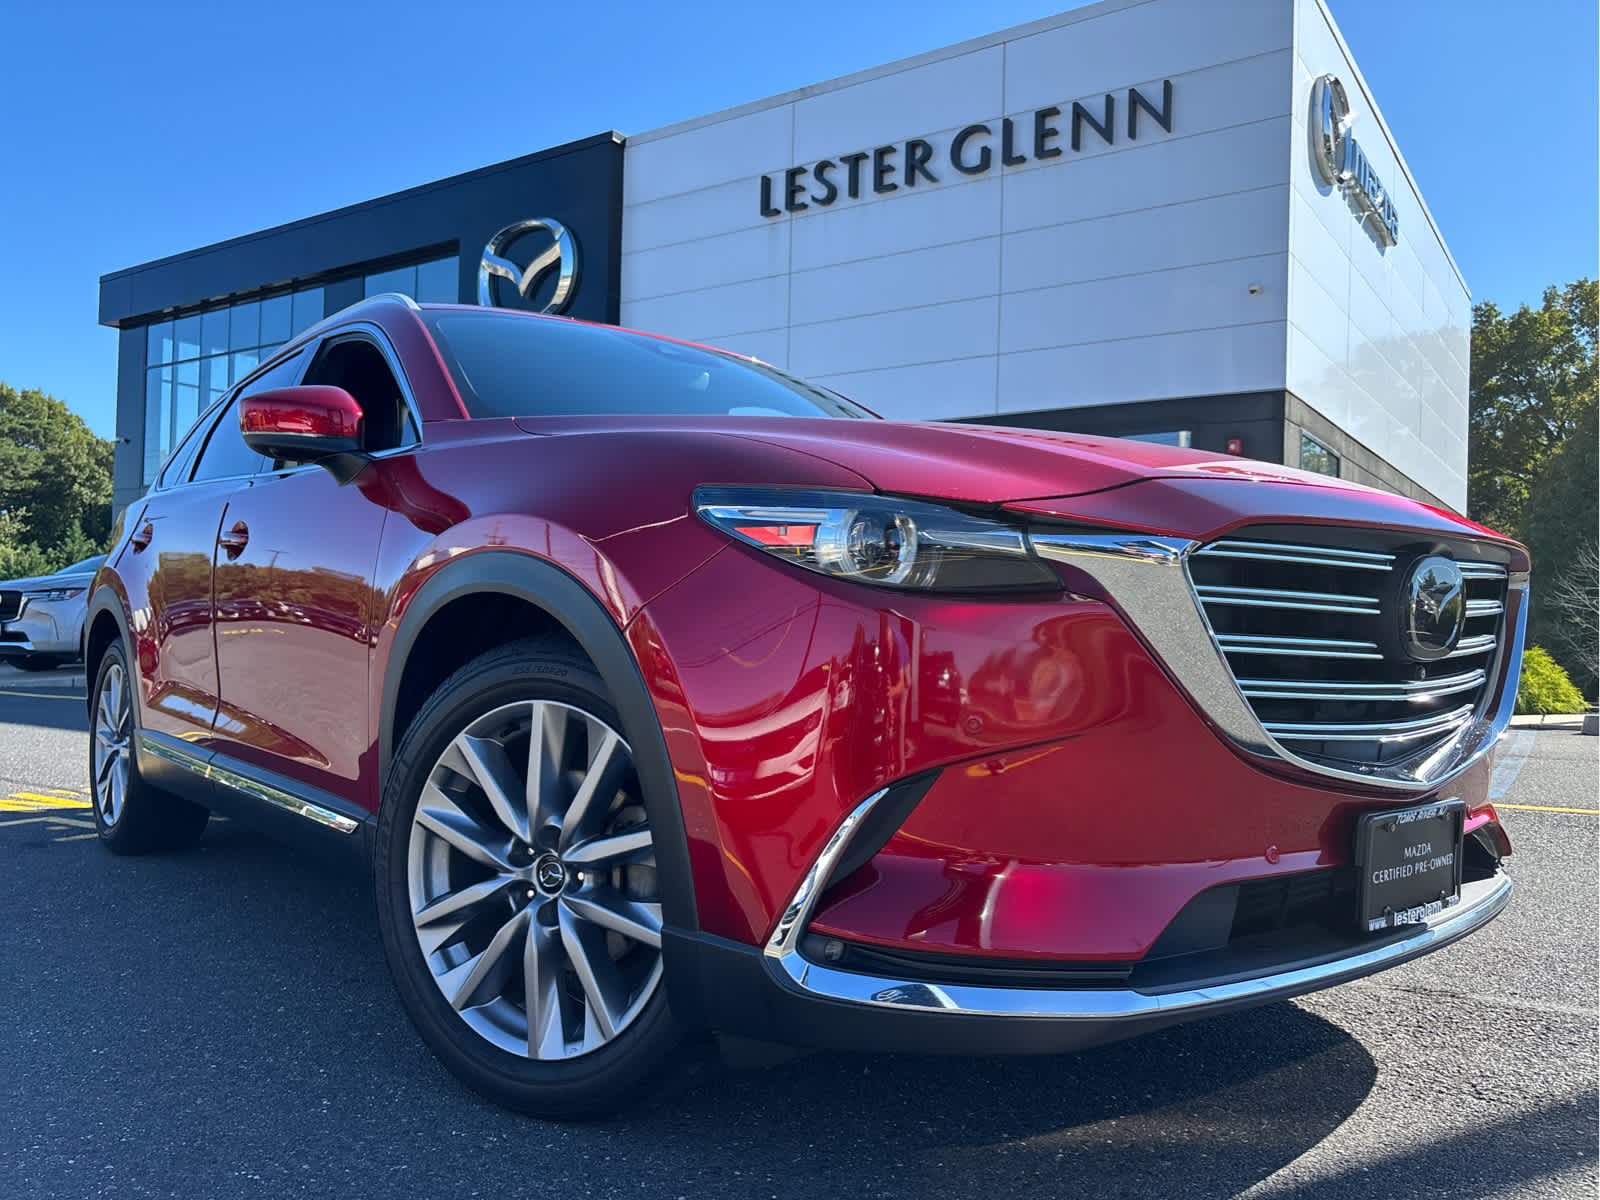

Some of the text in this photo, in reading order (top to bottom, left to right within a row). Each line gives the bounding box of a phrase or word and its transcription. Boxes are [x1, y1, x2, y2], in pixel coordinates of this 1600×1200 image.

[760, 79, 1173, 218] LESTER GLENN
[1404, 843, 1432, 857] MAZDA
[1372, 852, 1454, 884] CERTIFIED PRE-OWNED
